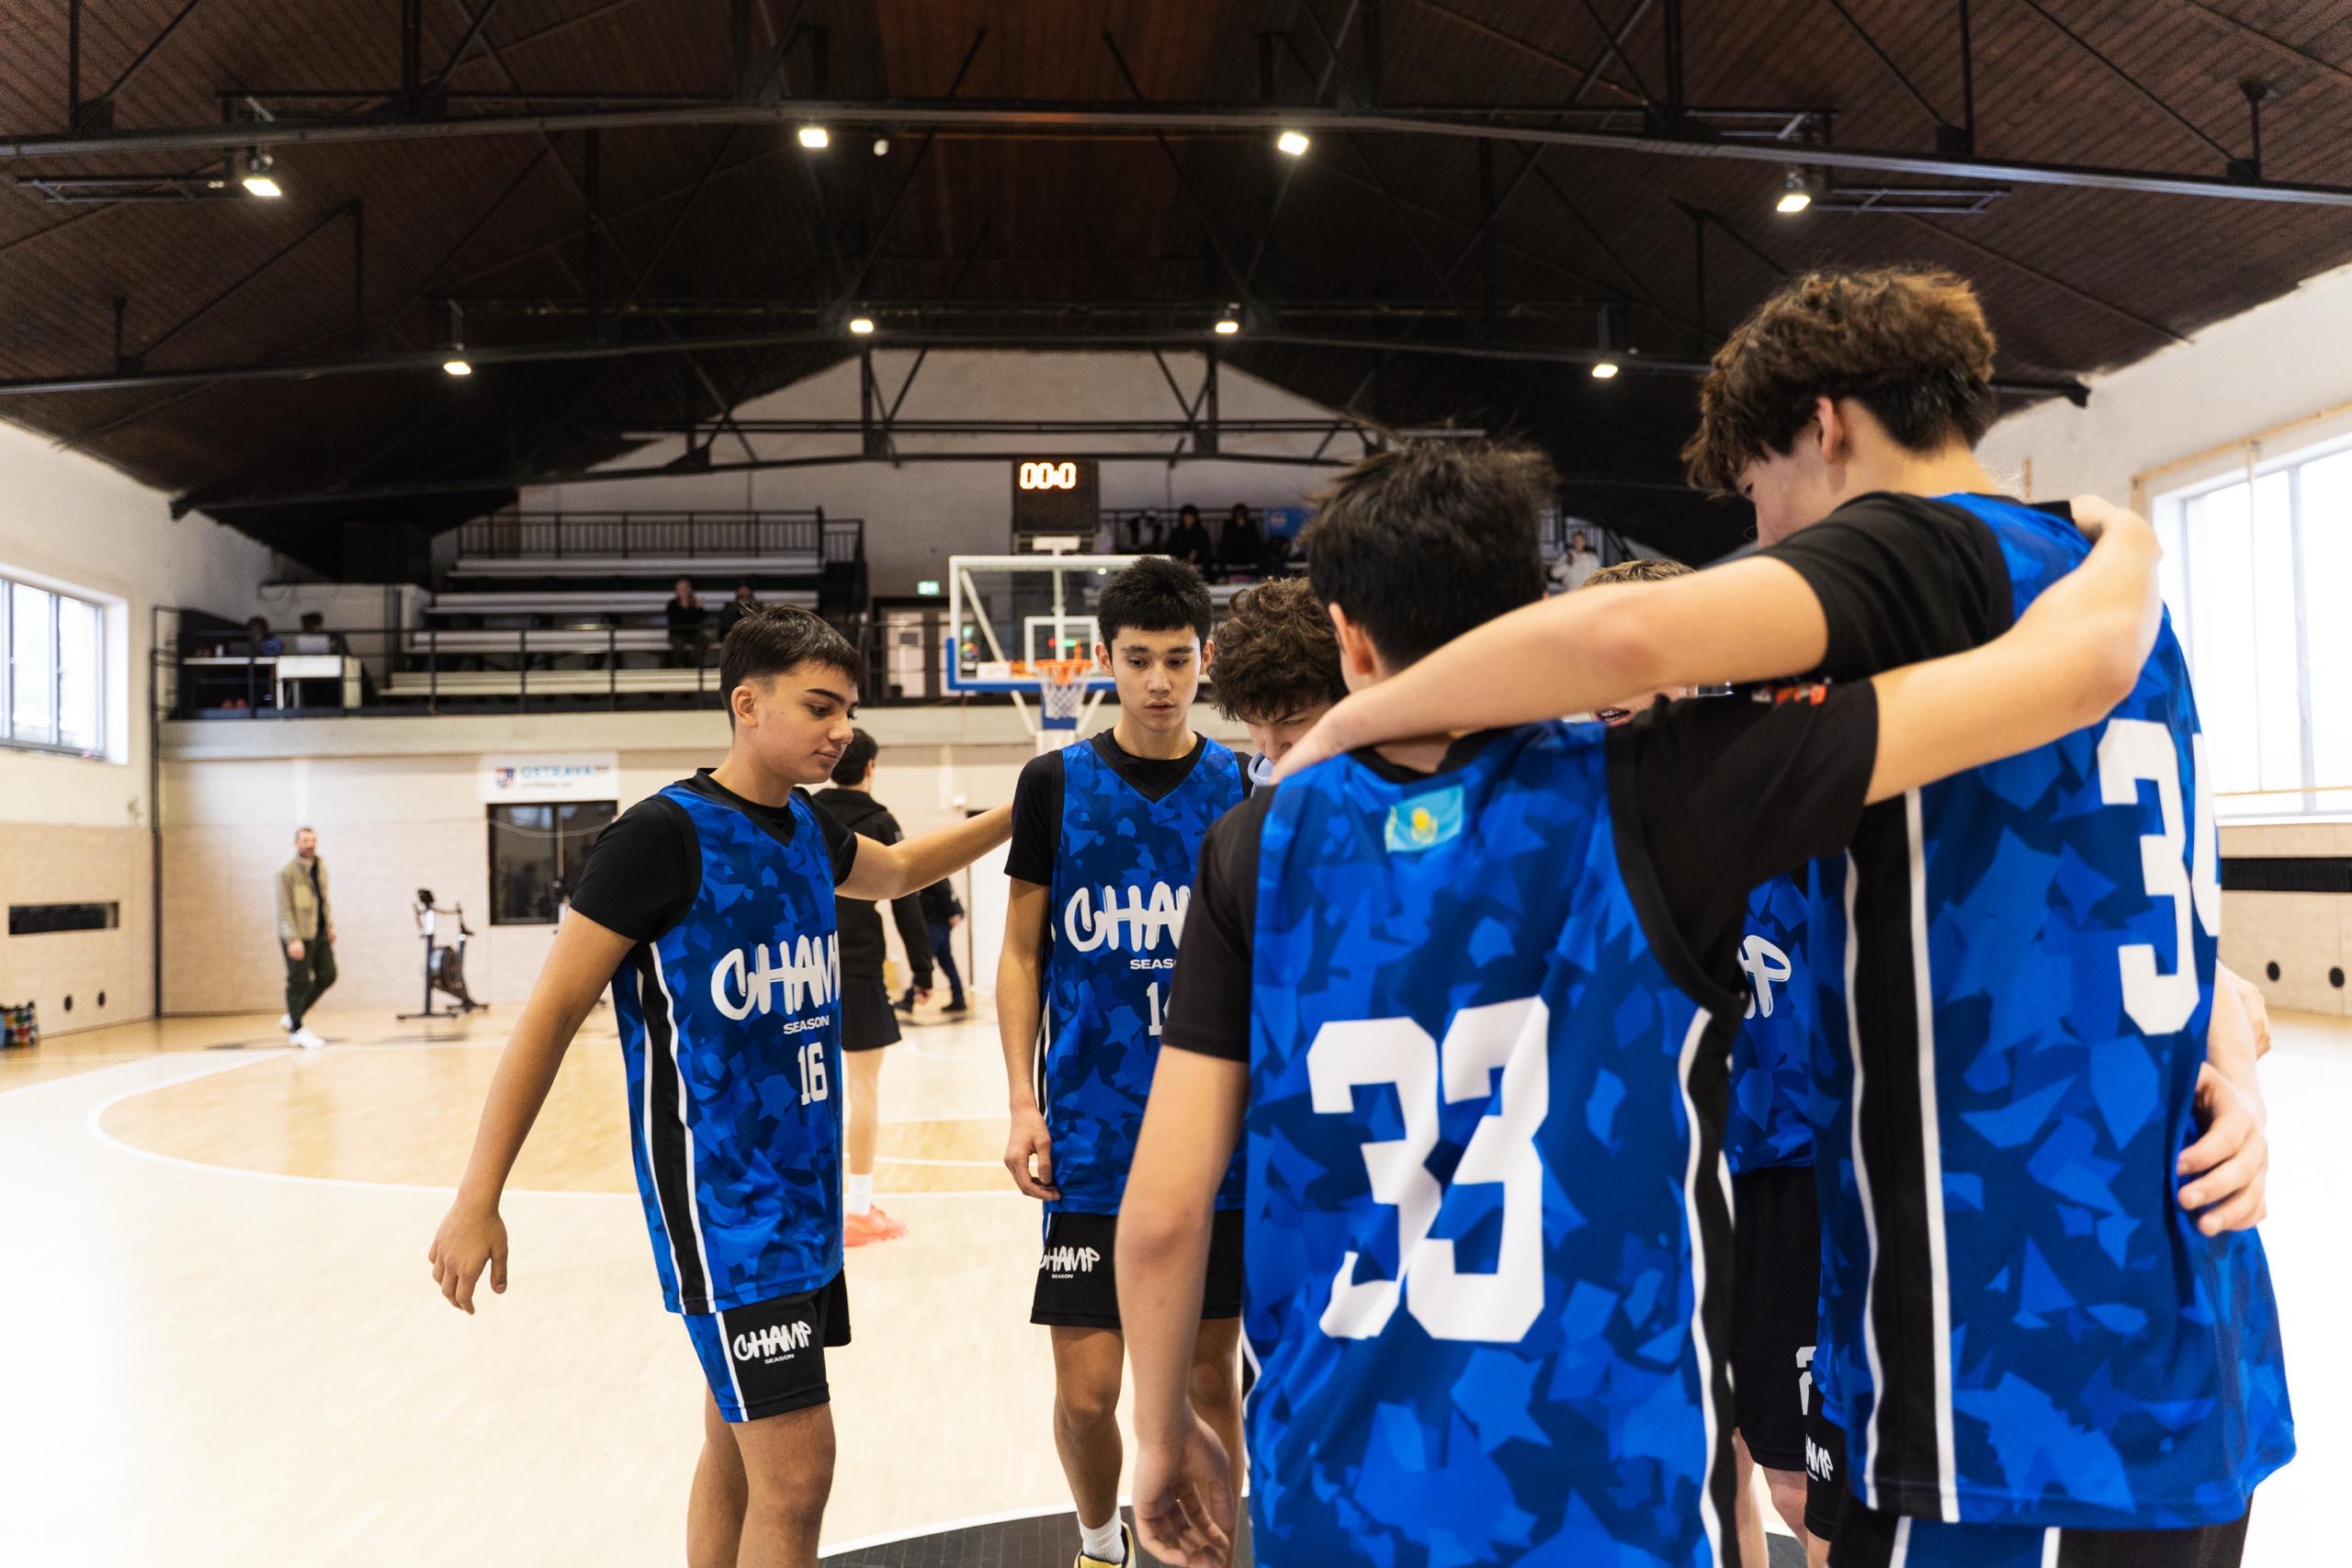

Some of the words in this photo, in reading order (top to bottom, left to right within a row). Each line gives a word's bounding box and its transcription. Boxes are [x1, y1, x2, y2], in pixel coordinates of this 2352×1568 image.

[1064, 881, 1192, 953] CHA
[710, 931, 841, 1021] CHAM
[1129, 958, 1177, 970] SEAS
[783, 1014, 830, 1035] SEASON
[1146, 982, 1172, 1036] 1
[797, 1042, 828, 1106] 16
[1306, 995, 1550, 1344] 33
[733, 1320, 812, 1361] CHAMP
[763, 1353, 795, 1365] SEASON
